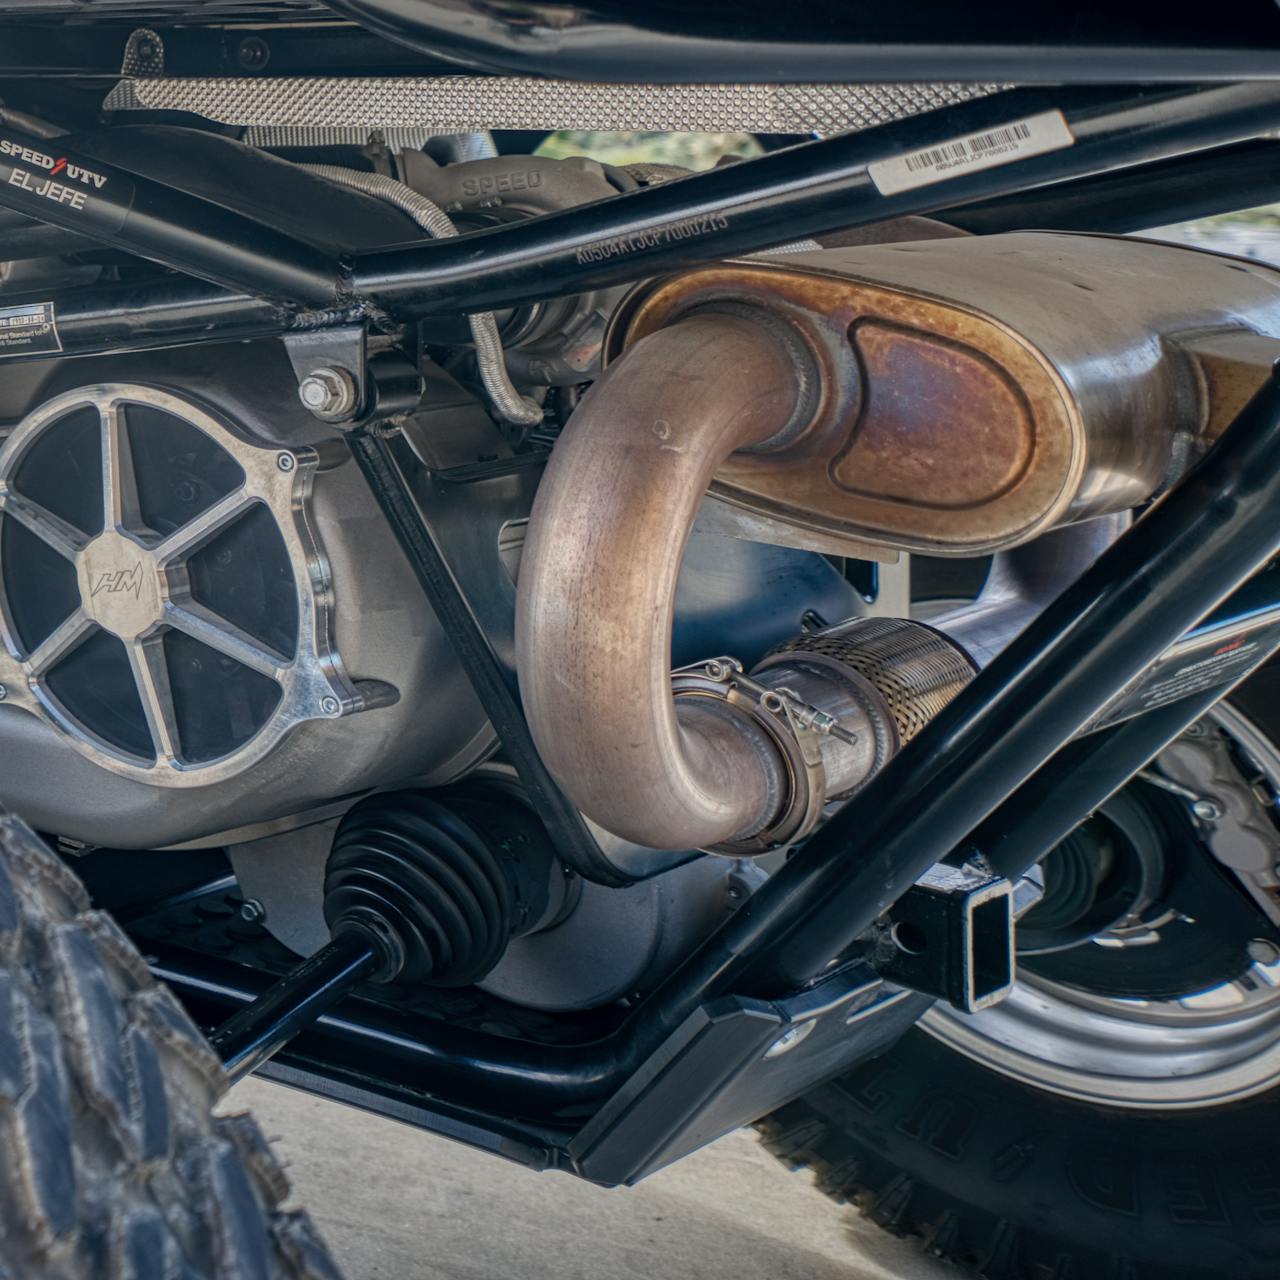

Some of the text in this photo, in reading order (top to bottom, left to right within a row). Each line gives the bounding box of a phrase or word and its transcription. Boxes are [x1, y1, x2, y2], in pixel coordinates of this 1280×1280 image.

[0, 139, 108, 189] SPEED UTV
[462, 170, 544, 197] SPEED
[8, 167, 88, 210] EL JEFE
